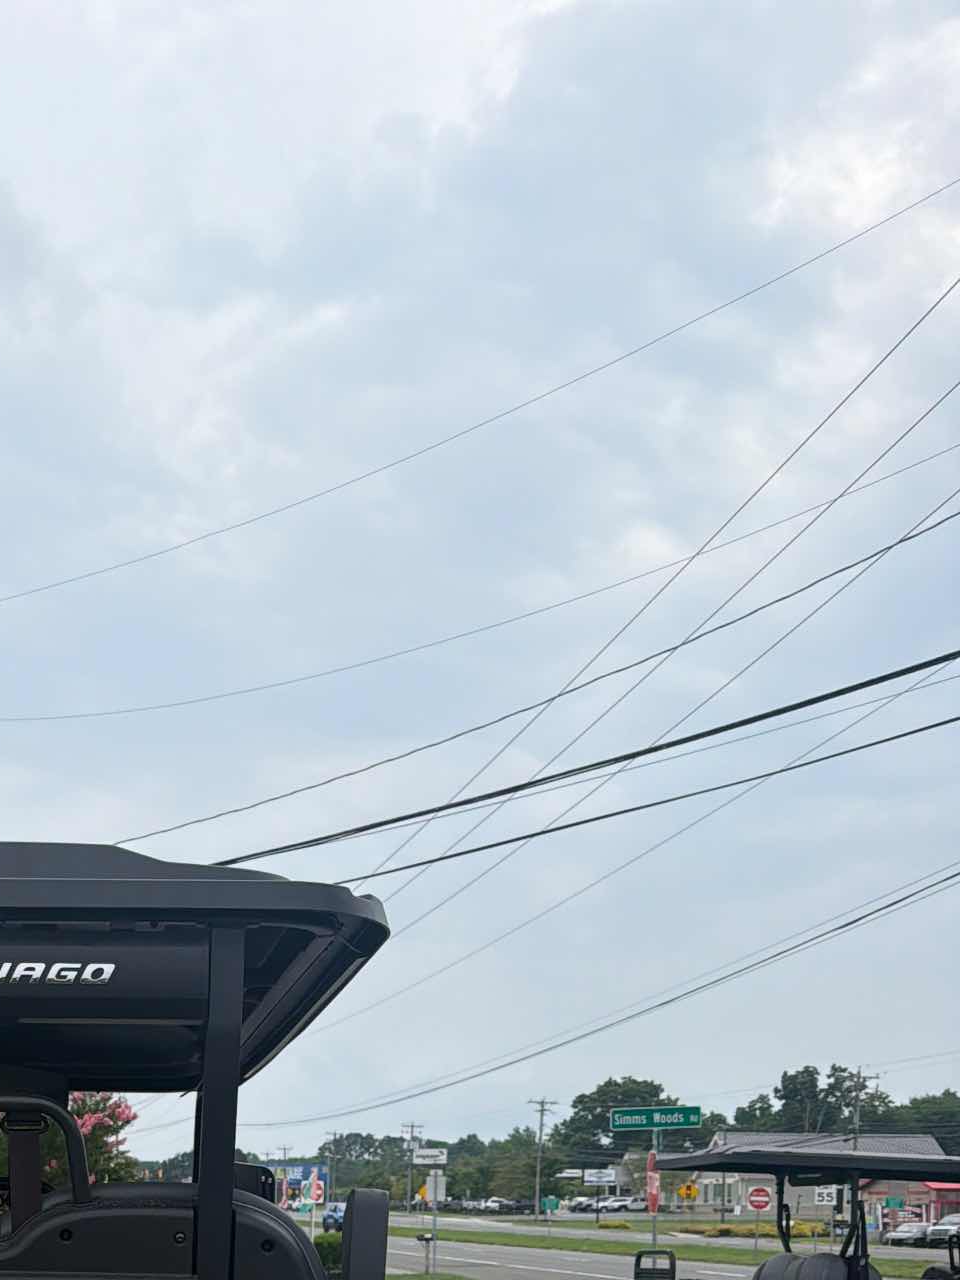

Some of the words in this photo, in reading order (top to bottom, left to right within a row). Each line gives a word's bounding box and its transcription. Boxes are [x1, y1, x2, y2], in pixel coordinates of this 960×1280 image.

[614, 1114, 647, 1125] Simms
[653, 1112, 684, 1123] Woods
[817, 1191, 833, 1203] 55
